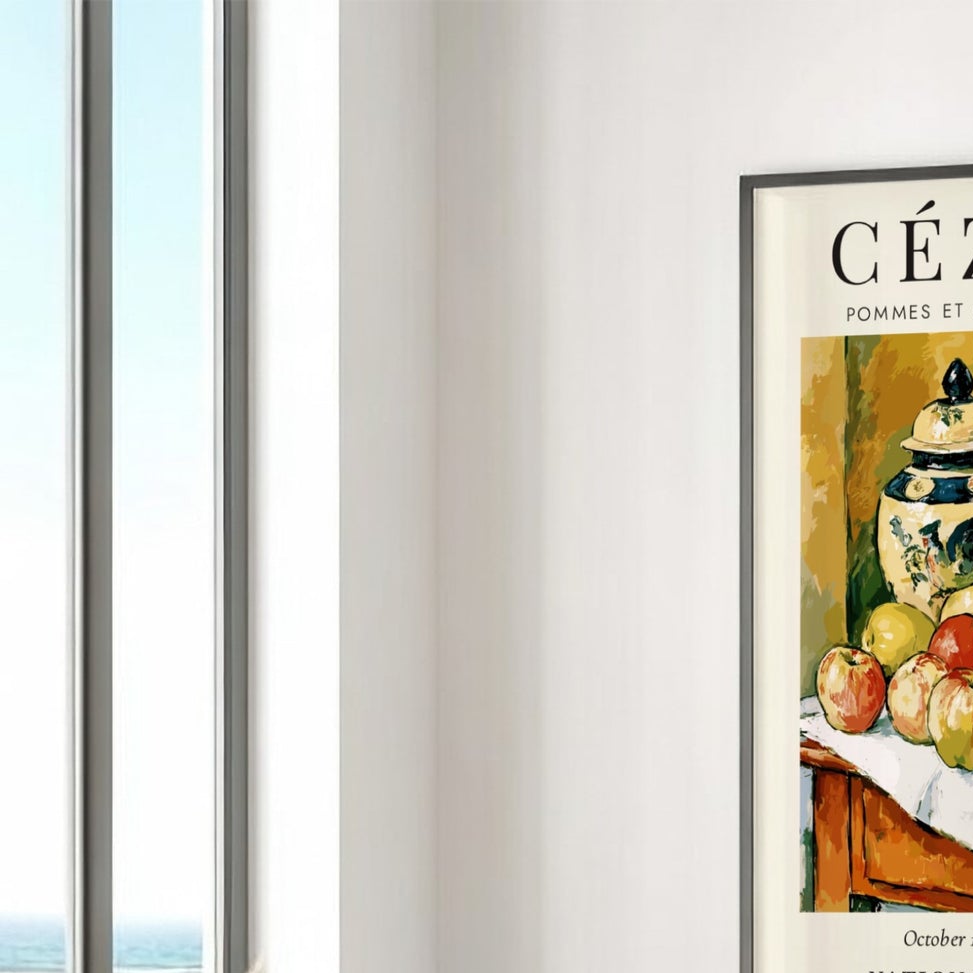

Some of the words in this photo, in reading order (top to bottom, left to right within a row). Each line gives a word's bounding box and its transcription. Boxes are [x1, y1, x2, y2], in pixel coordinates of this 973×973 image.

[847, 304, 930, 322] POMMES
[943, 303, 963, 318] ET
[904, 928, 966, 947] October
